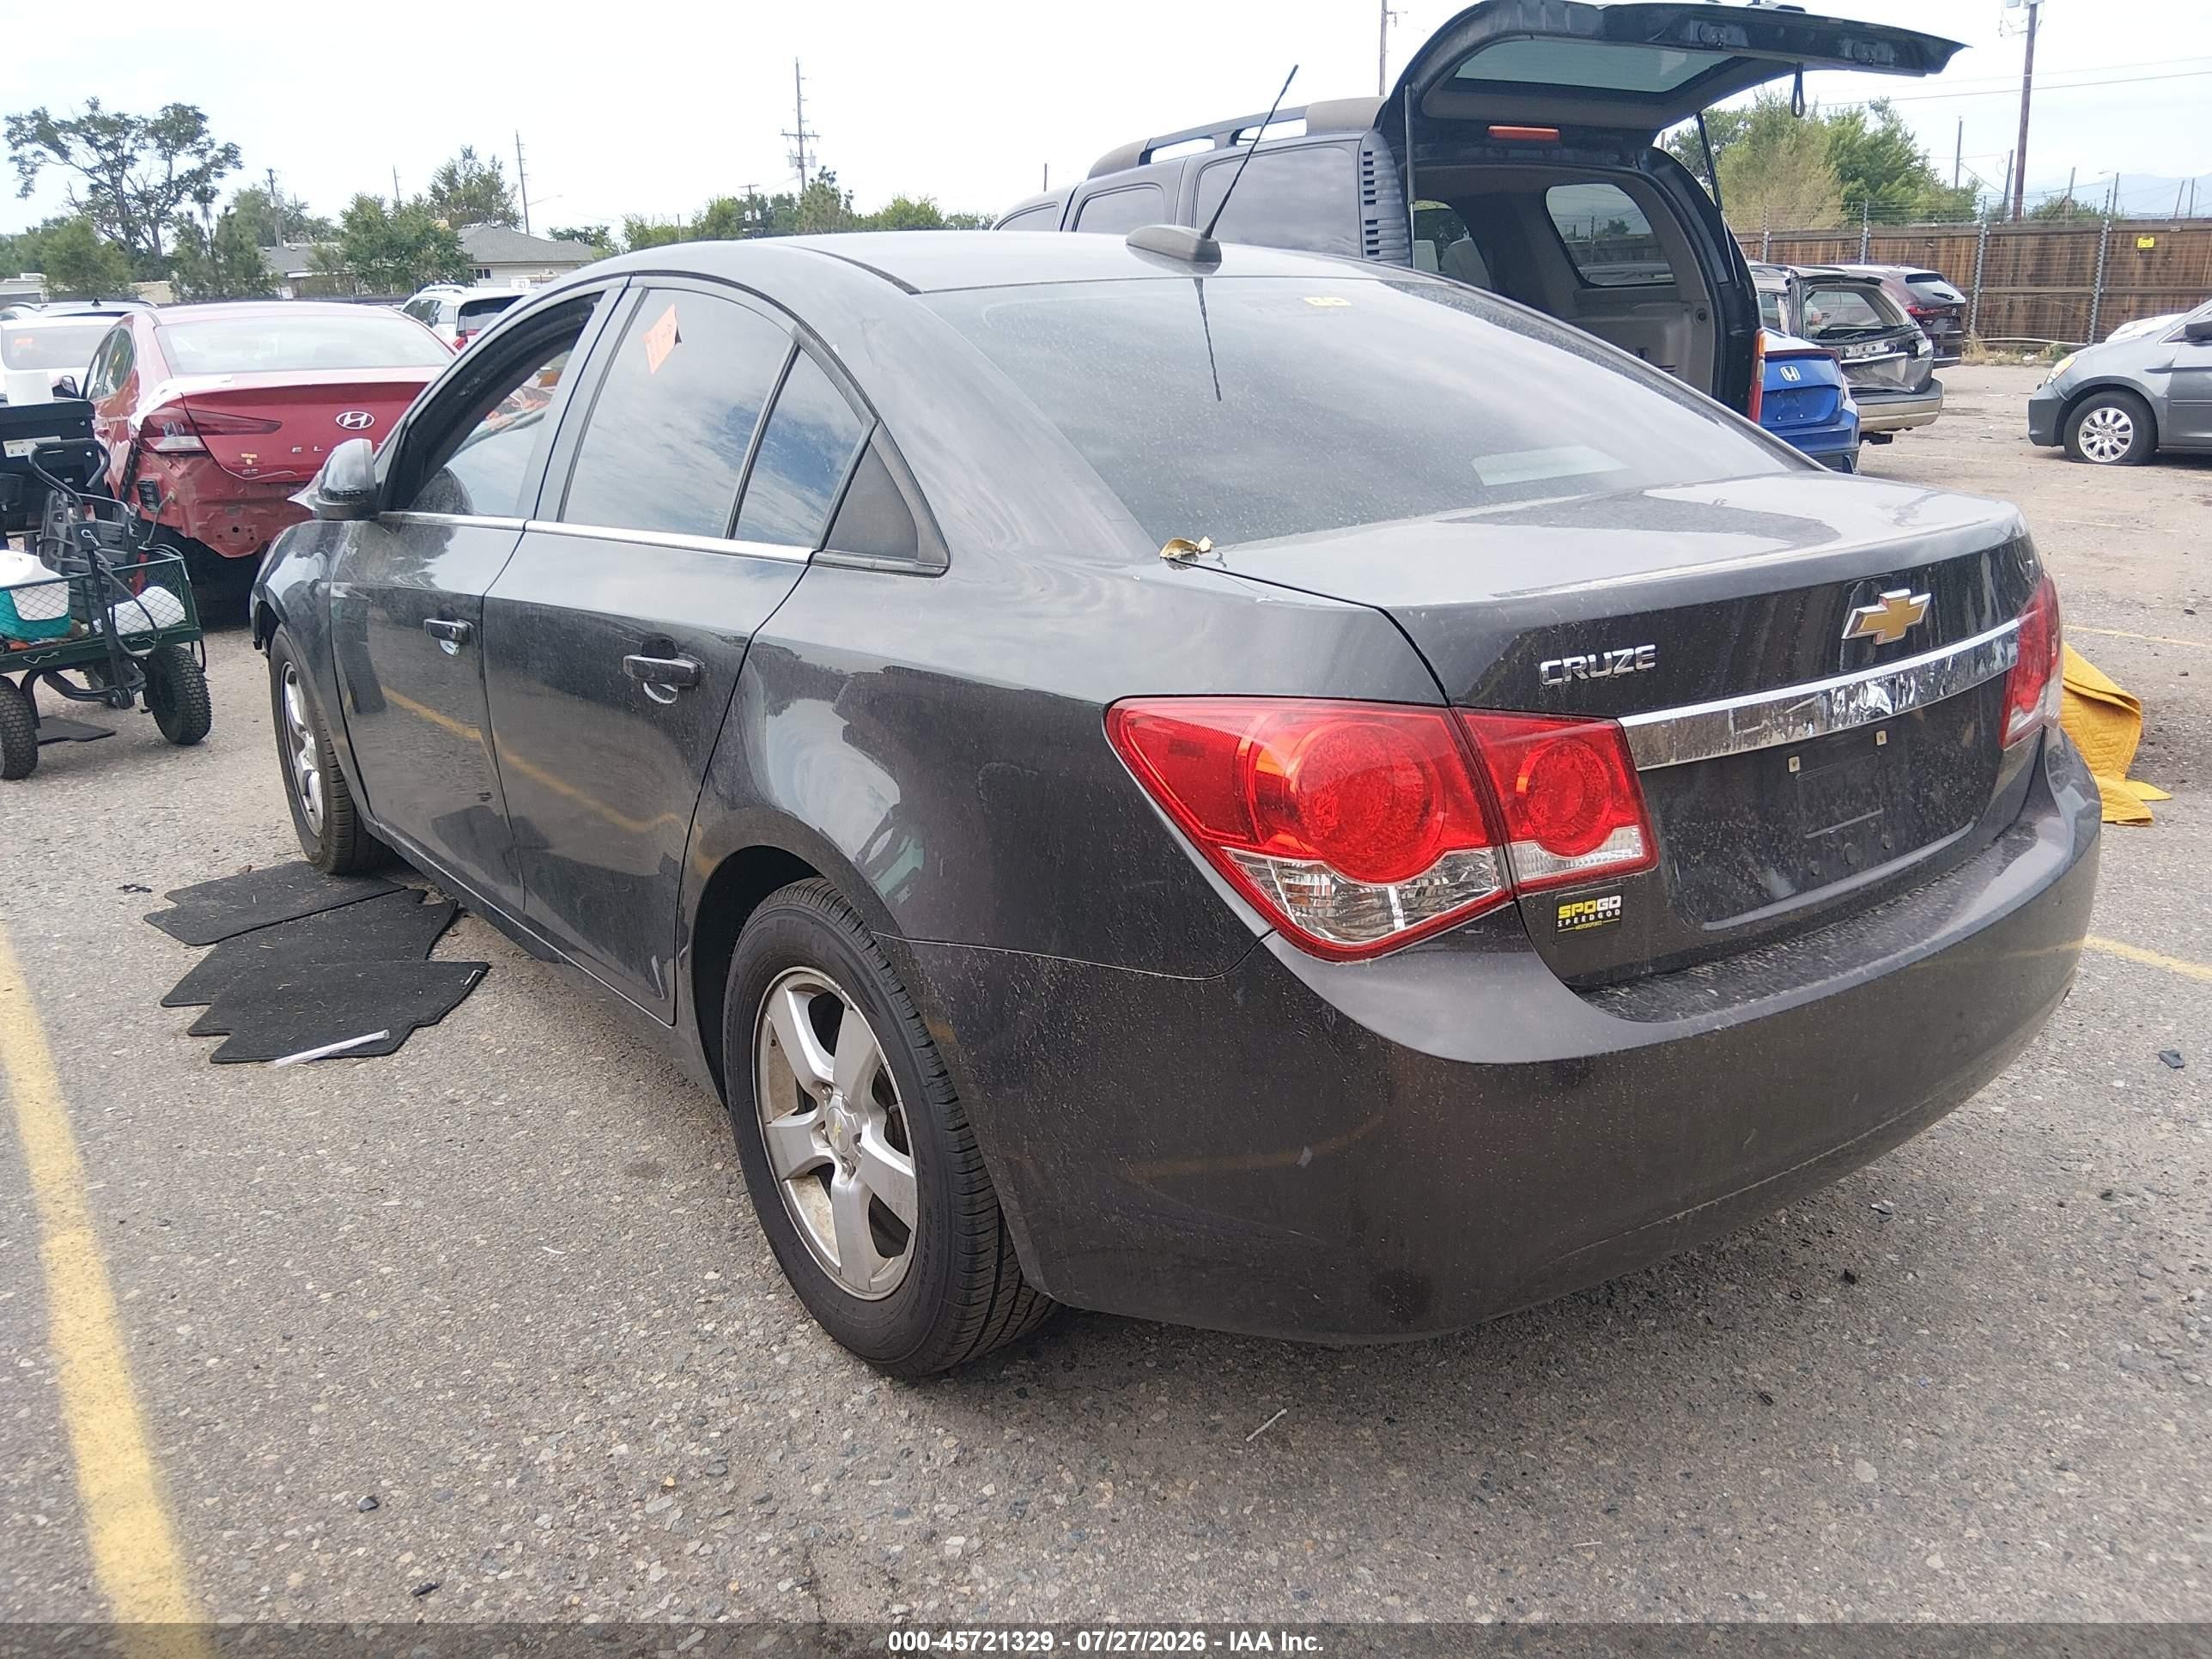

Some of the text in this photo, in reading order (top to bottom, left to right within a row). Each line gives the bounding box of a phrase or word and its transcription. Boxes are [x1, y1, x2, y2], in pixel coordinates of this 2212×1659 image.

[1540, 644, 1656, 685] CRUZE
[1557, 908, 1621, 927] SPEEDGOD
[1558, 895, 1622, 920] SPOGO
